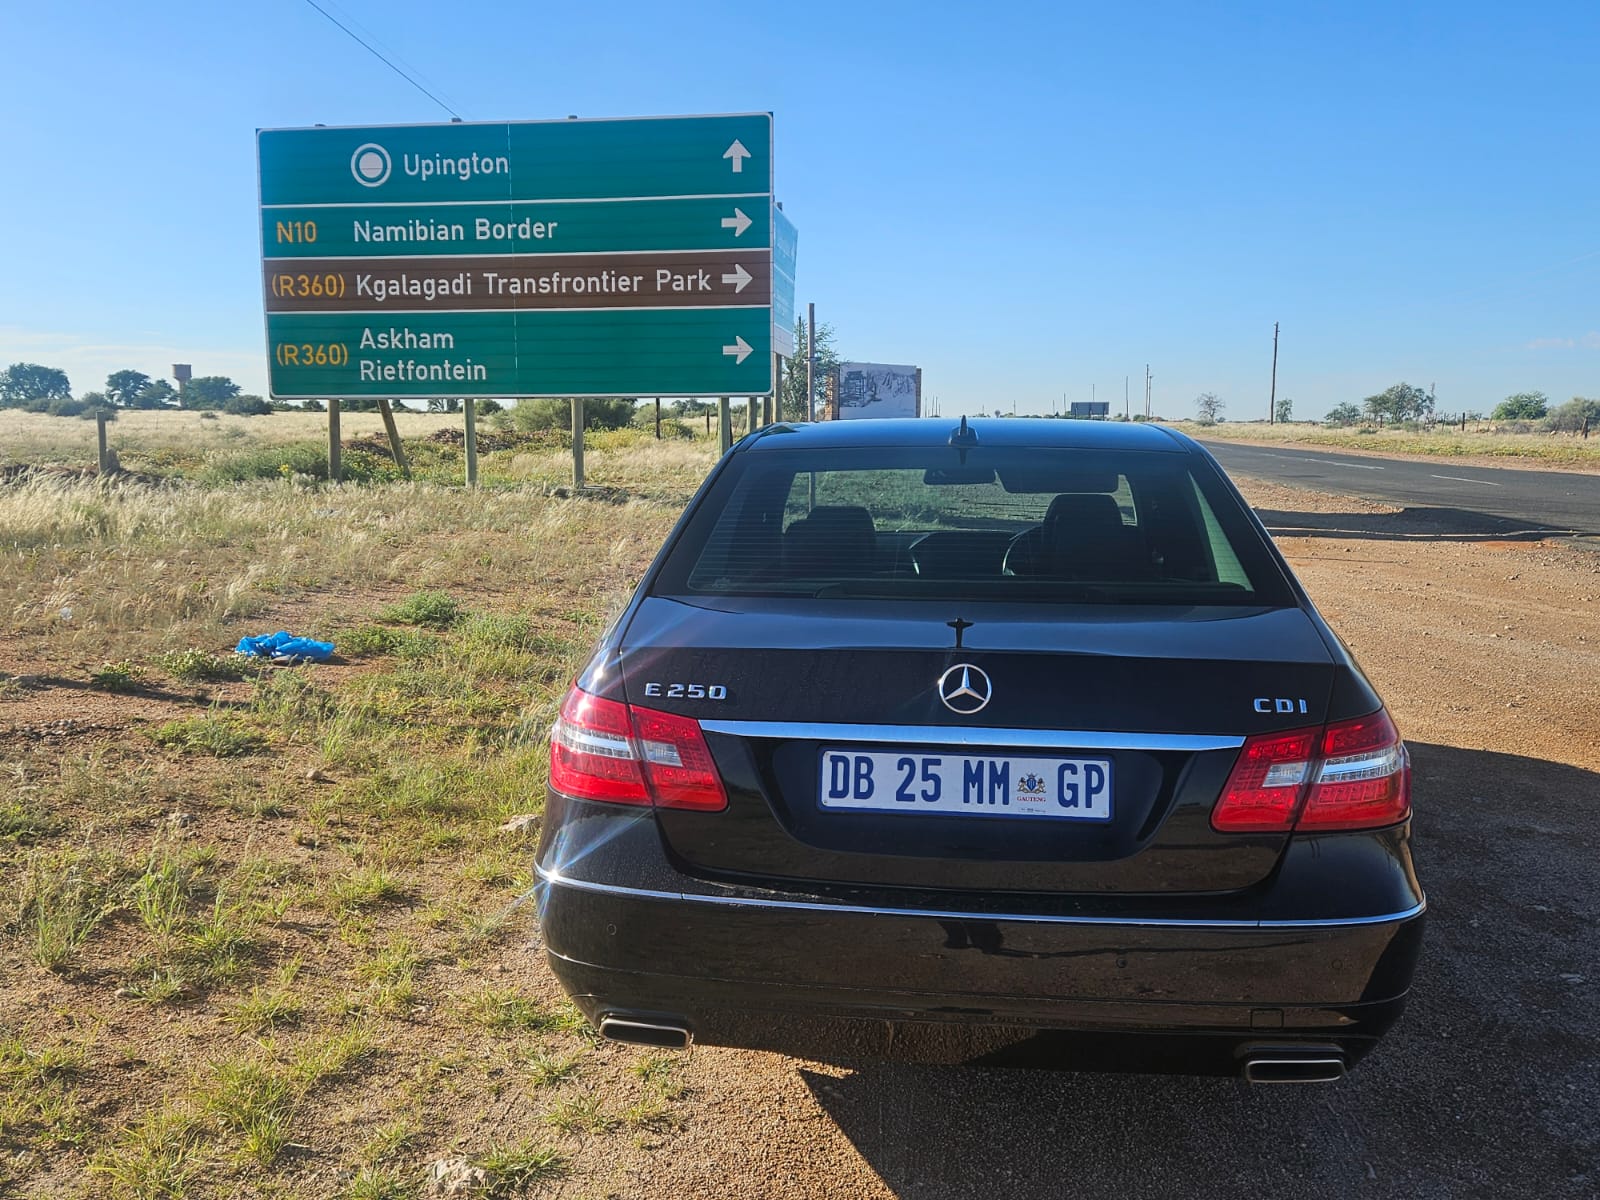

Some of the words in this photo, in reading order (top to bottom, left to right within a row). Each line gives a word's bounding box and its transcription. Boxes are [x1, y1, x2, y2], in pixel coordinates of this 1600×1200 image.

[403, 152, 509, 181] Upington
[276, 220, 318, 243] N10
[353, 218, 464, 242] Namibian
[475, 217, 558, 240] Border
[271, 273, 346, 297] (R360)
[356, 272, 472, 301] Kgalagadi
[483, 270, 643, 295] Transfrontier
[656, 268, 712, 292] Park
[359, 327, 454, 349] Askham
[276, 343, 349, 366] (R360)
[360, 358, 487, 380] Rietfontein
[1253, 698, 1307, 713] CDI
[828, 755, 875, 800] DB
[895, 757, 942, 802] 25
[963, 759, 1010, 805] MM
[1057, 763, 1105, 809] GP
